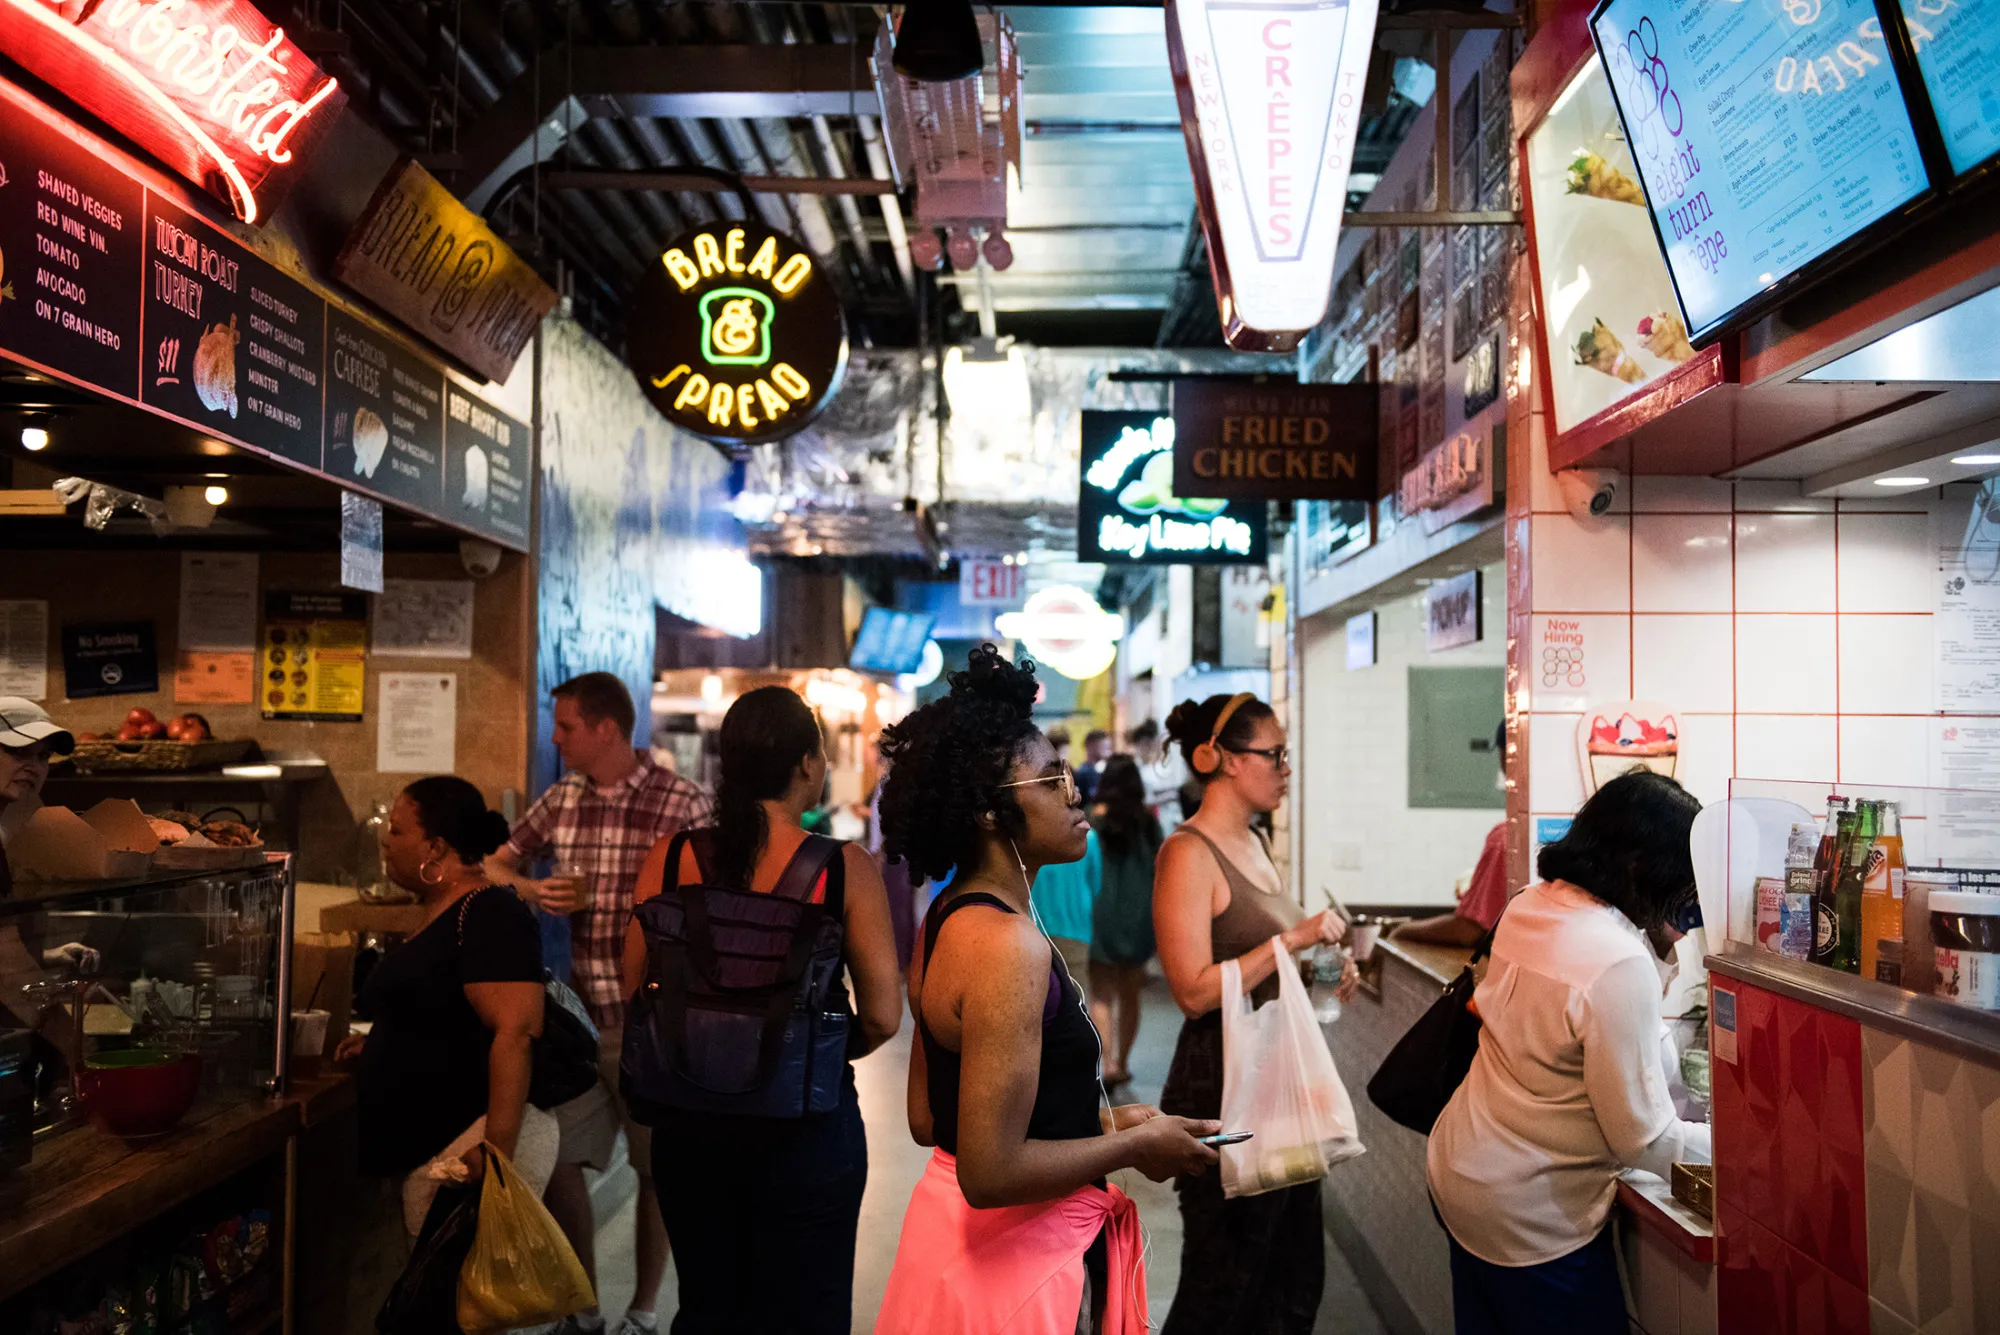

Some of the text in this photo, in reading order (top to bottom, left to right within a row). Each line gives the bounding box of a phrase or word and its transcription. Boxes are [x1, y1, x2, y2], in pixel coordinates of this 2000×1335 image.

[1194, 53, 1233, 193] NEW YORK
[1262, 19, 1293, 245] CRÊPES
[1327, 72, 1356, 170] TOKYO
[1655, 138, 1701, 202] eight
[37, 169, 80, 207] SHAVED
[81, 193, 123, 231] VEGGIES
[1668, 190, 1714, 241] turn
[37, 200, 109, 255] RED WINE VIN.
[36, 232, 80, 270] TOMATO
[154, 215, 240, 294] TUSCAN ROAST
[662, 227, 812, 293] BREAD
[36, 266, 86, 305] AVOCADO
[154, 259, 204, 320] TURKEY
[250, 286, 300, 325] SLICED TURKEY
[36, 299, 121, 351] ON 7 GRAIN HERO
[250, 313, 306, 356] CRISPY SHALLOTS
[711, 297, 758, 355] &
[158, 336, 181, 374] $11
[249, 340, 318, 387] CRANBERRY MUSTARD
[334, 349, 381, 399] CAPRESE
[248, 368, 280, 395] MUNSTER
[651, 362, 812, 428] SPREAD
[248, 397, 302, 431] ON 7 GRAIN HERO
[450, 392, 471, 424] BEEF
[1222, 416, 1330, 446] FRIED
[1192, 449, 1357, 480] CHICKEN
[1099, 513, 1252, 558] Key Lime Pie
[972, 563, 1020, 599] EXIT
[78, 633, 140, 649] No Smoking
[1543, 632, 1584, 647] Hiring
[1547, 618, 1580, 632] Now
